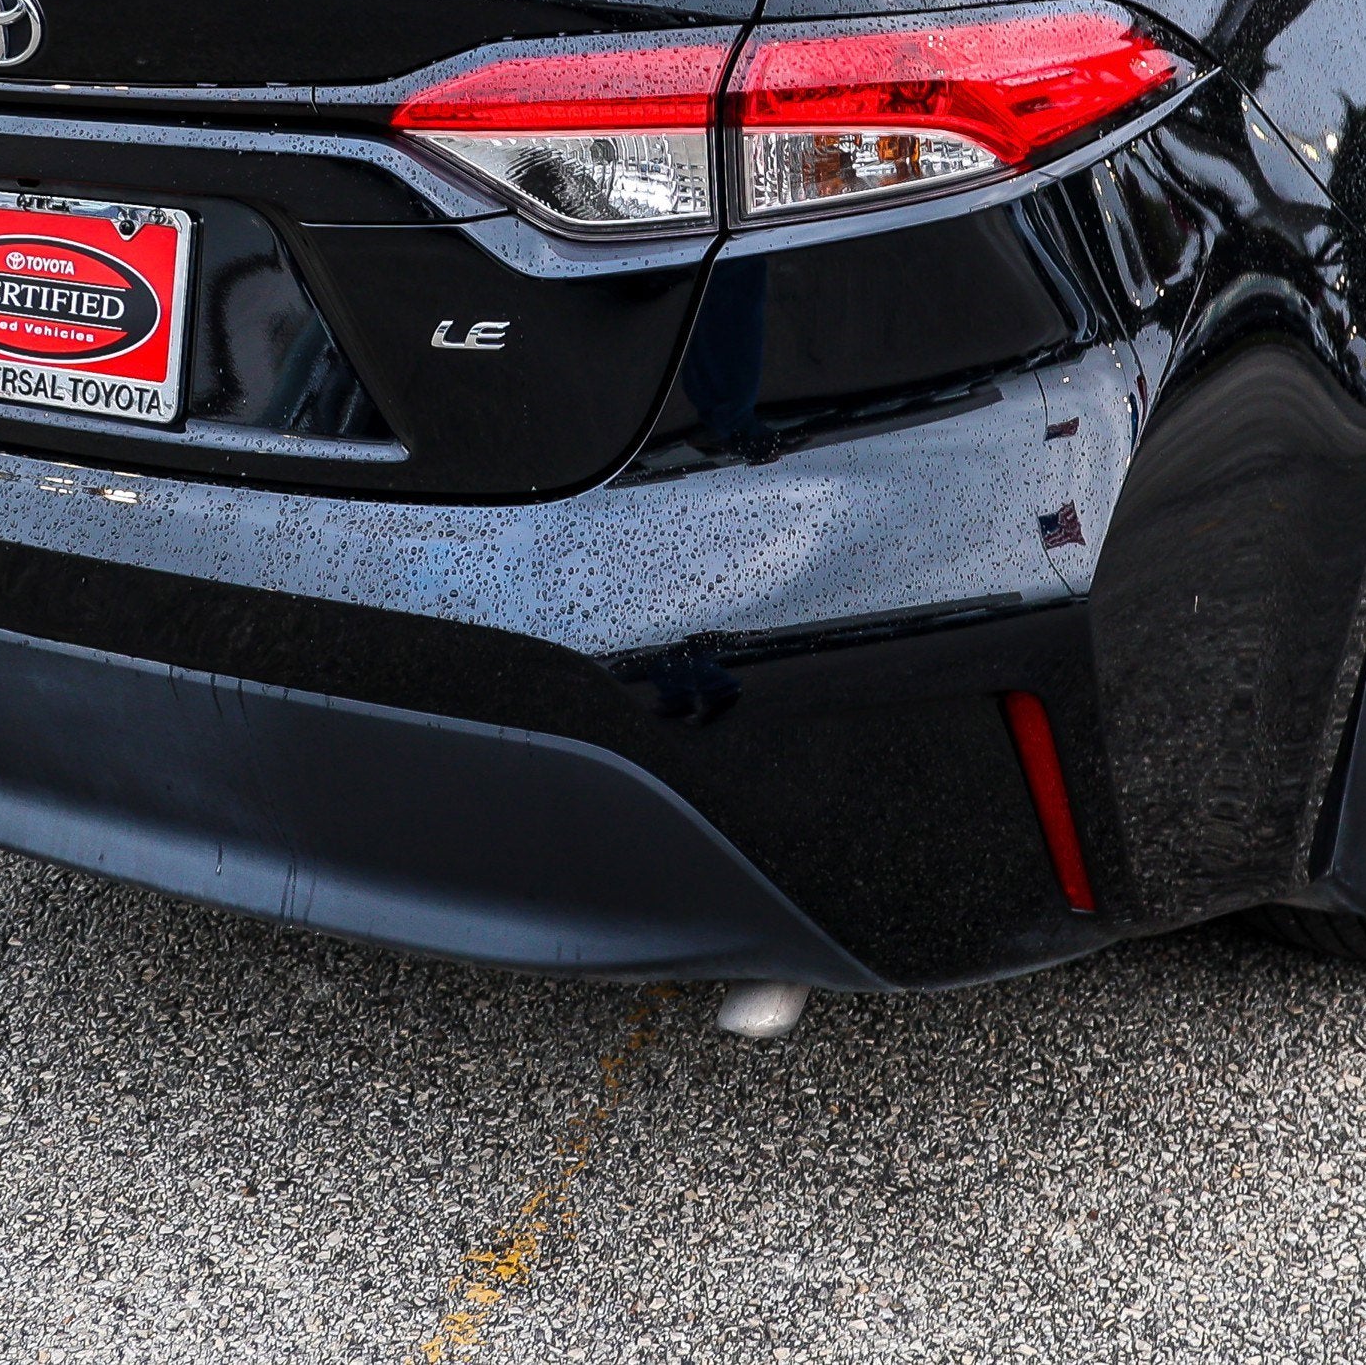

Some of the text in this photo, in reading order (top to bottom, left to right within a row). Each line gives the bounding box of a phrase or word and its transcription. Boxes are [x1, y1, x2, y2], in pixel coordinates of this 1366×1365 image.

[26, 256, 75, 276] TOYOTA
[24, 322, 95, 343] Vehicles
[431, 320, 510, 349] LE
[69, 377, 163, 415] TOYOTA
